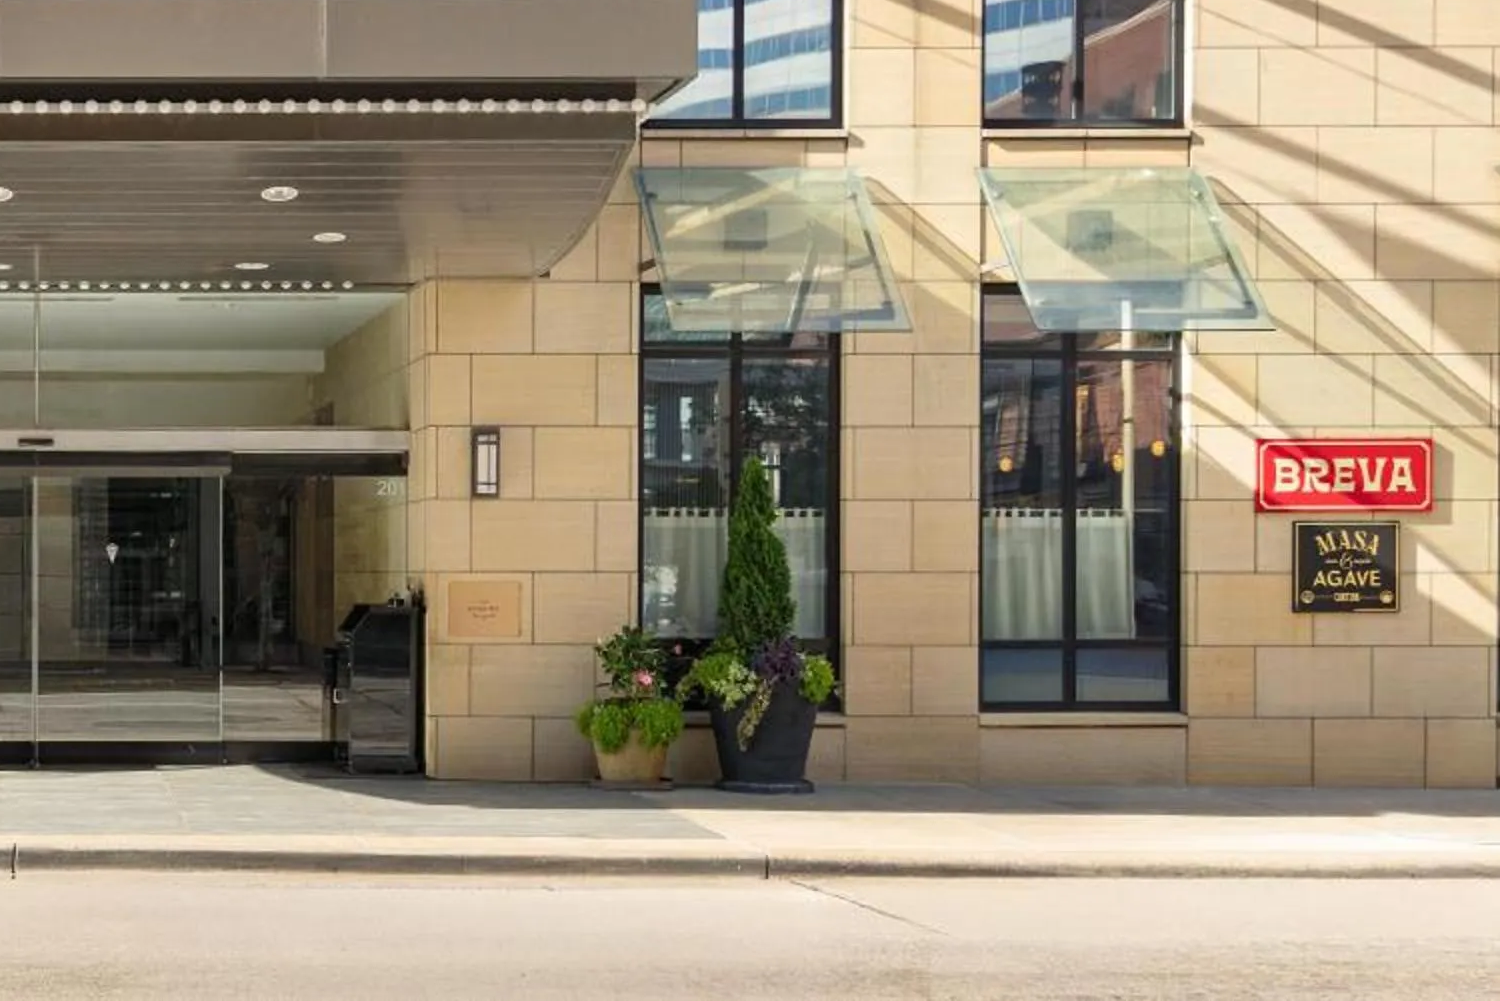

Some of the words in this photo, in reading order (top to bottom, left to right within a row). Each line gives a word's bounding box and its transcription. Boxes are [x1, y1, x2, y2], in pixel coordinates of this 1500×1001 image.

[1273, 458, 1416, 492] BREVA
[1315, 530, 1379, 556] MASA
[1313, 570, 1381, 587] AGAVE
